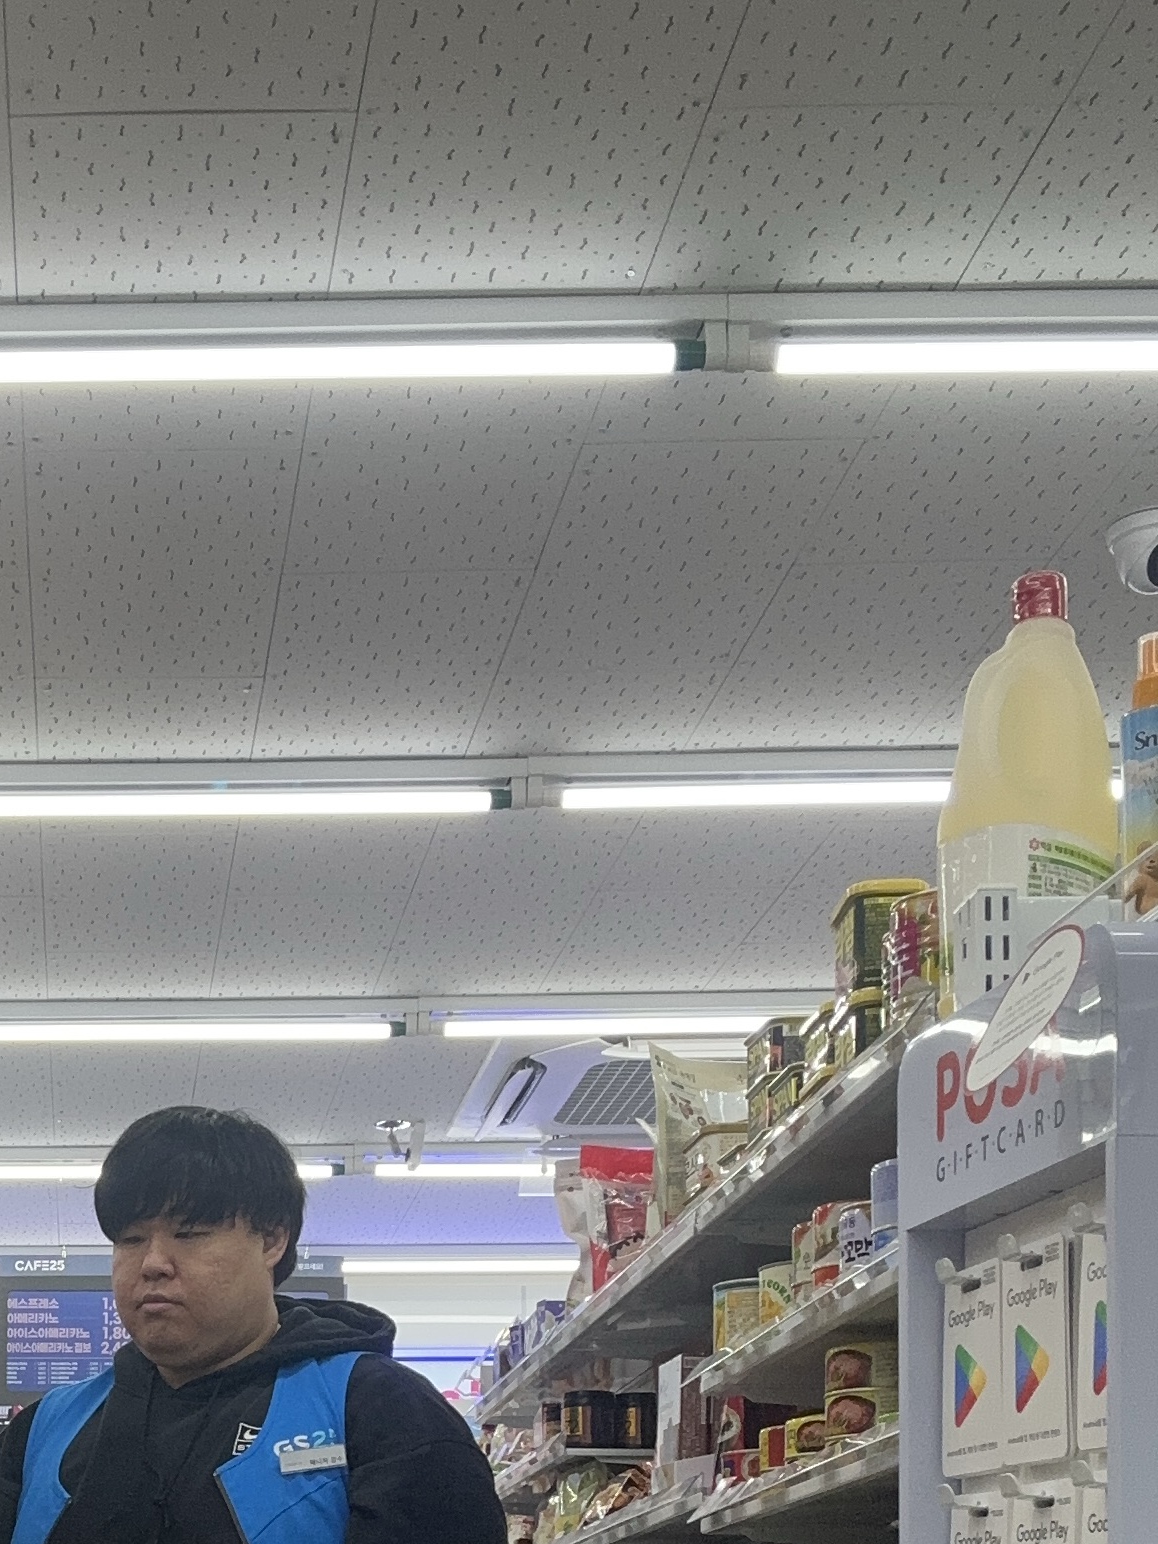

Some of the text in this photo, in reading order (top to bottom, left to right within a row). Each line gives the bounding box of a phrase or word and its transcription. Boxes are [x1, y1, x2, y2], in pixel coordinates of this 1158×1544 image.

[14, 1259, 65, 1272] CAFE25
[1007, 1278, 1058, 1307] Google Play
[7, 1297, 59, 1310] 에스프레소
[7, 1312, 59, 1324] 아메리카노
[948, 1300, 994, 1328] Google Play
[7, 1327, 91, 1339] 아이스아메리카노
[6, 1342, 74, 1354] 아이스아메리카노
[74, 1342, 92, 1354] 점보
[1050, 1520, 1069, 1543] Play
